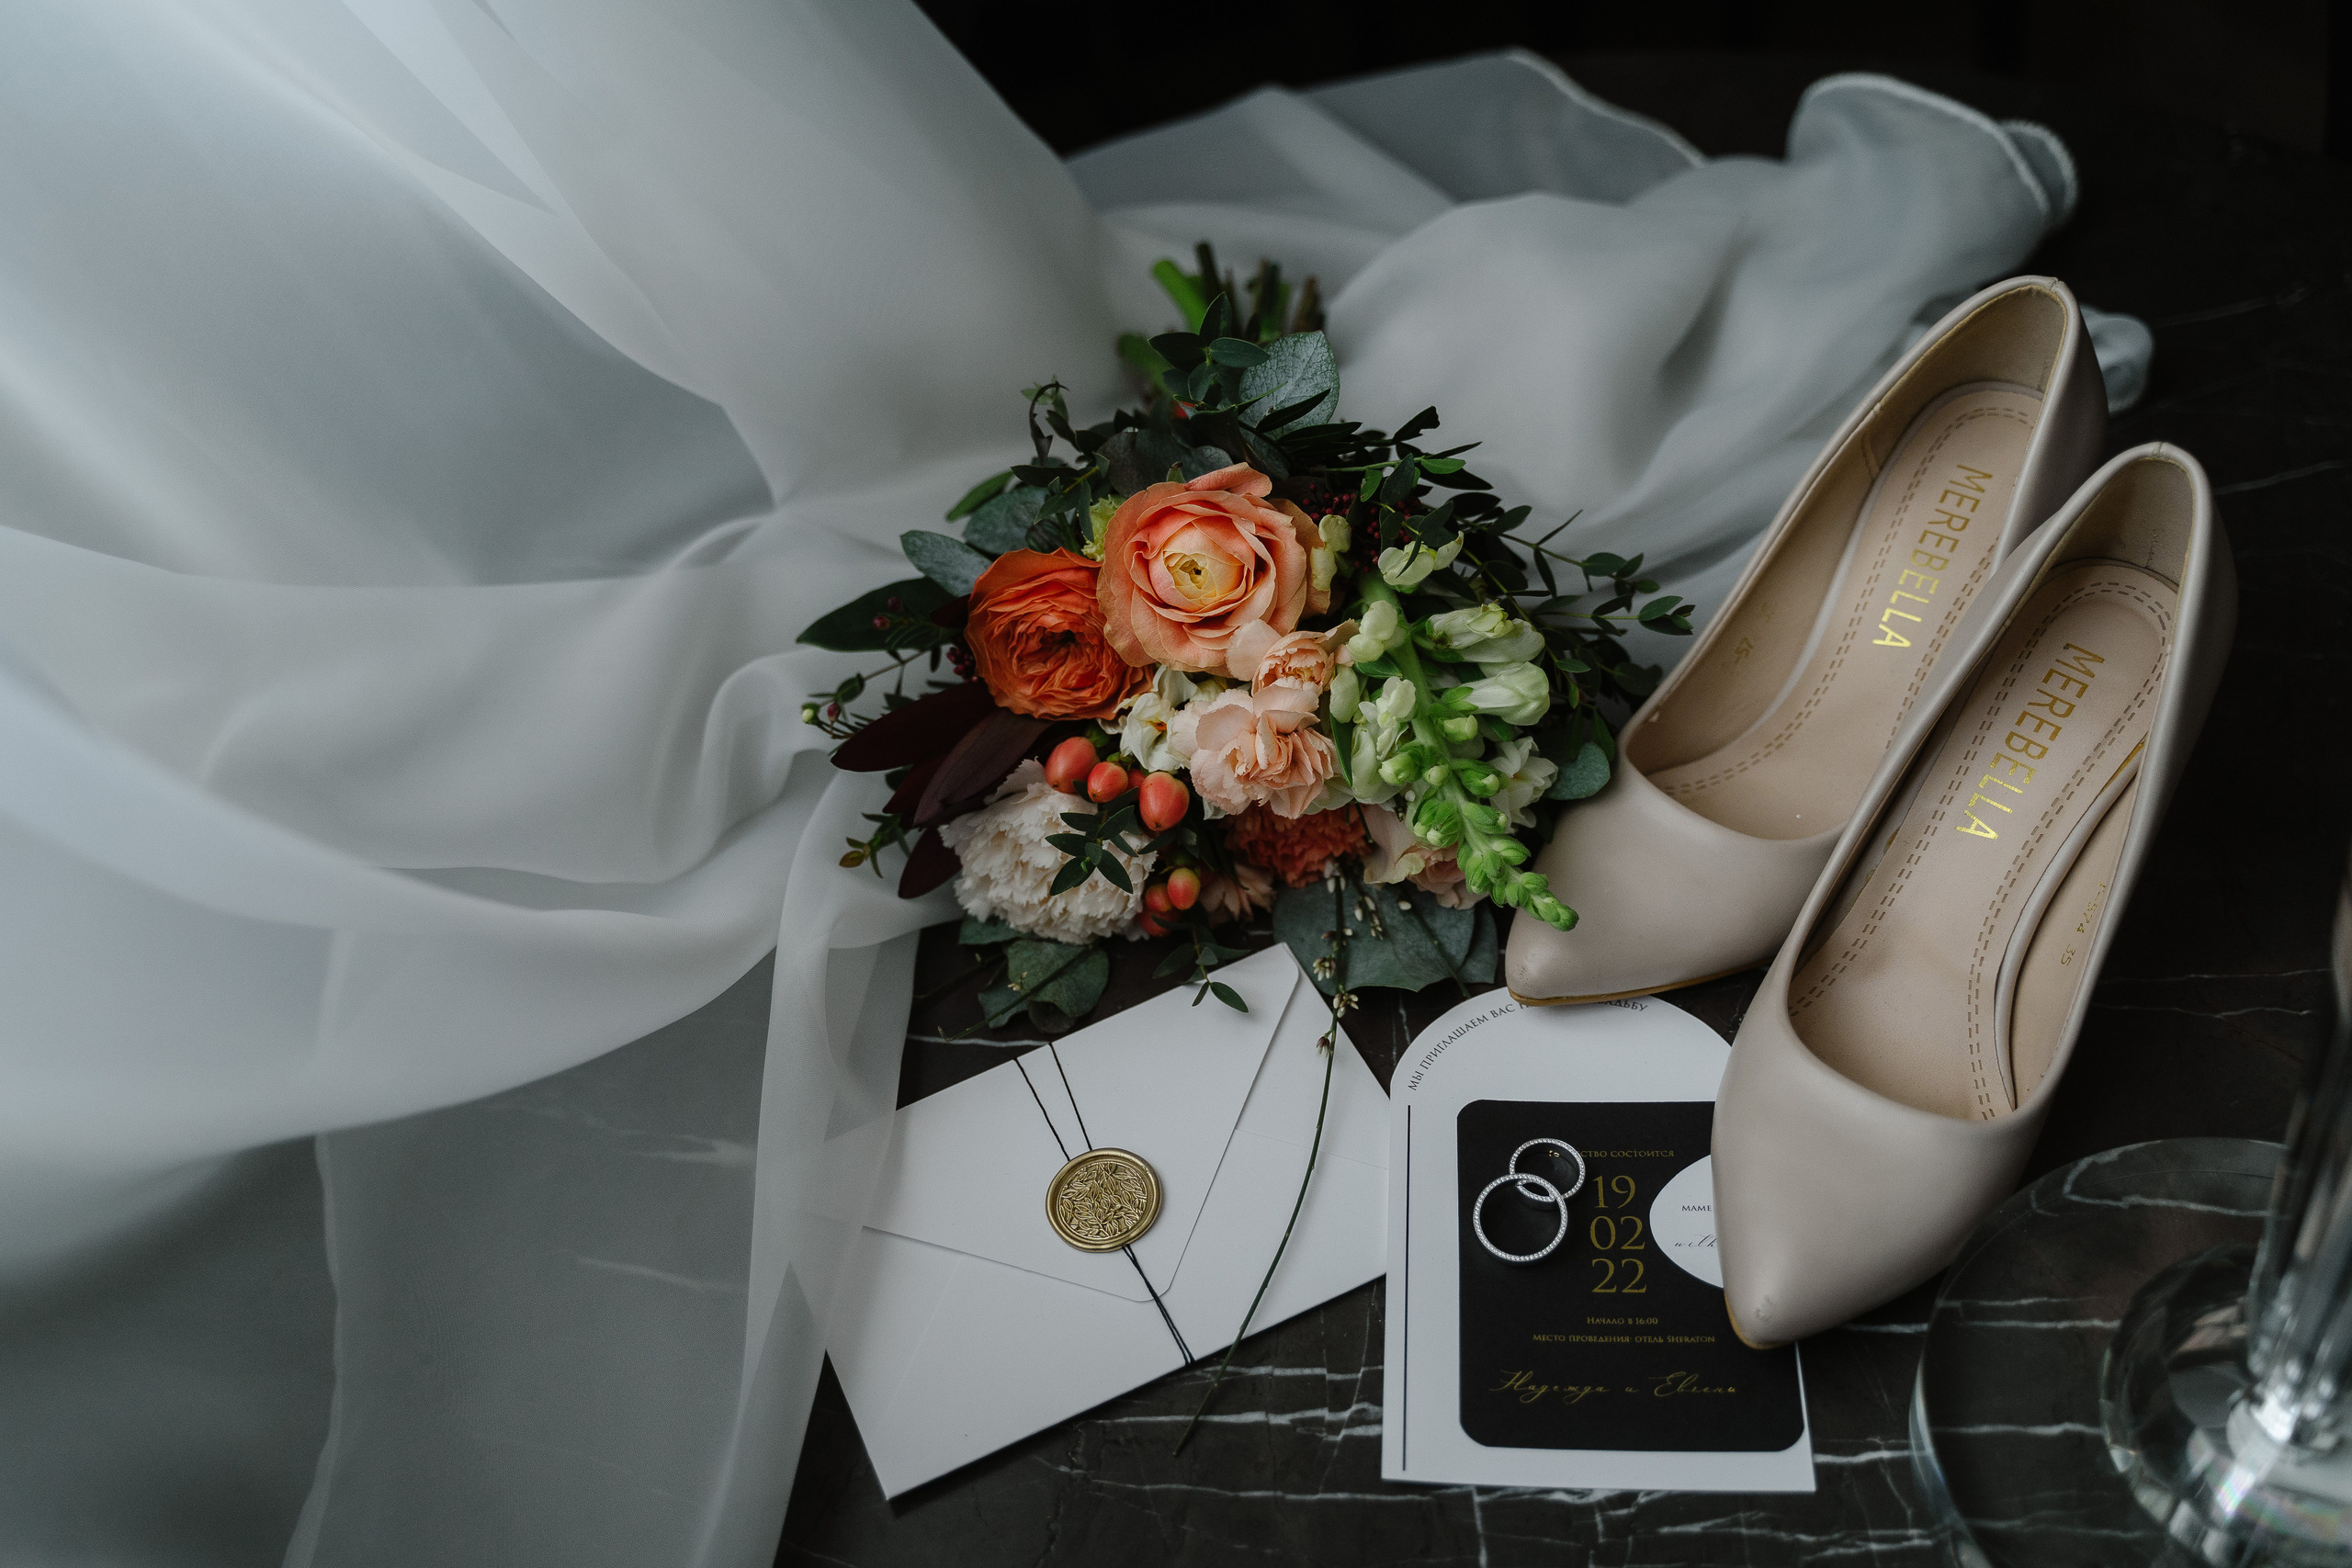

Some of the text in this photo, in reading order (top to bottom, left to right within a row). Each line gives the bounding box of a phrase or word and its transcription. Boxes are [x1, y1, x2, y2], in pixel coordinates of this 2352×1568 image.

[1872, 464, 1994, 649] MEREBELLA
[1955, 642, 2106, 840] MEREBELLA
[1408, 1070, 1424, 1091] МЫ
[1419, 1014, 1489, 1070] ПРИГЛАШАЕМ
[1489, 1003, 1516, 1019] ВАС
[1610, 1149, 1675, 1158] СОСТОИТСЯ
[1592, 1175, 1636, 1209] 19
[1589, 1215, 1645, 1250] 02
[1591, 1258, 1647, 1293] 22
[1635, 1316, 1658, 1325] 16:00
[1489, 1369, 1611, 1404] Надежда
